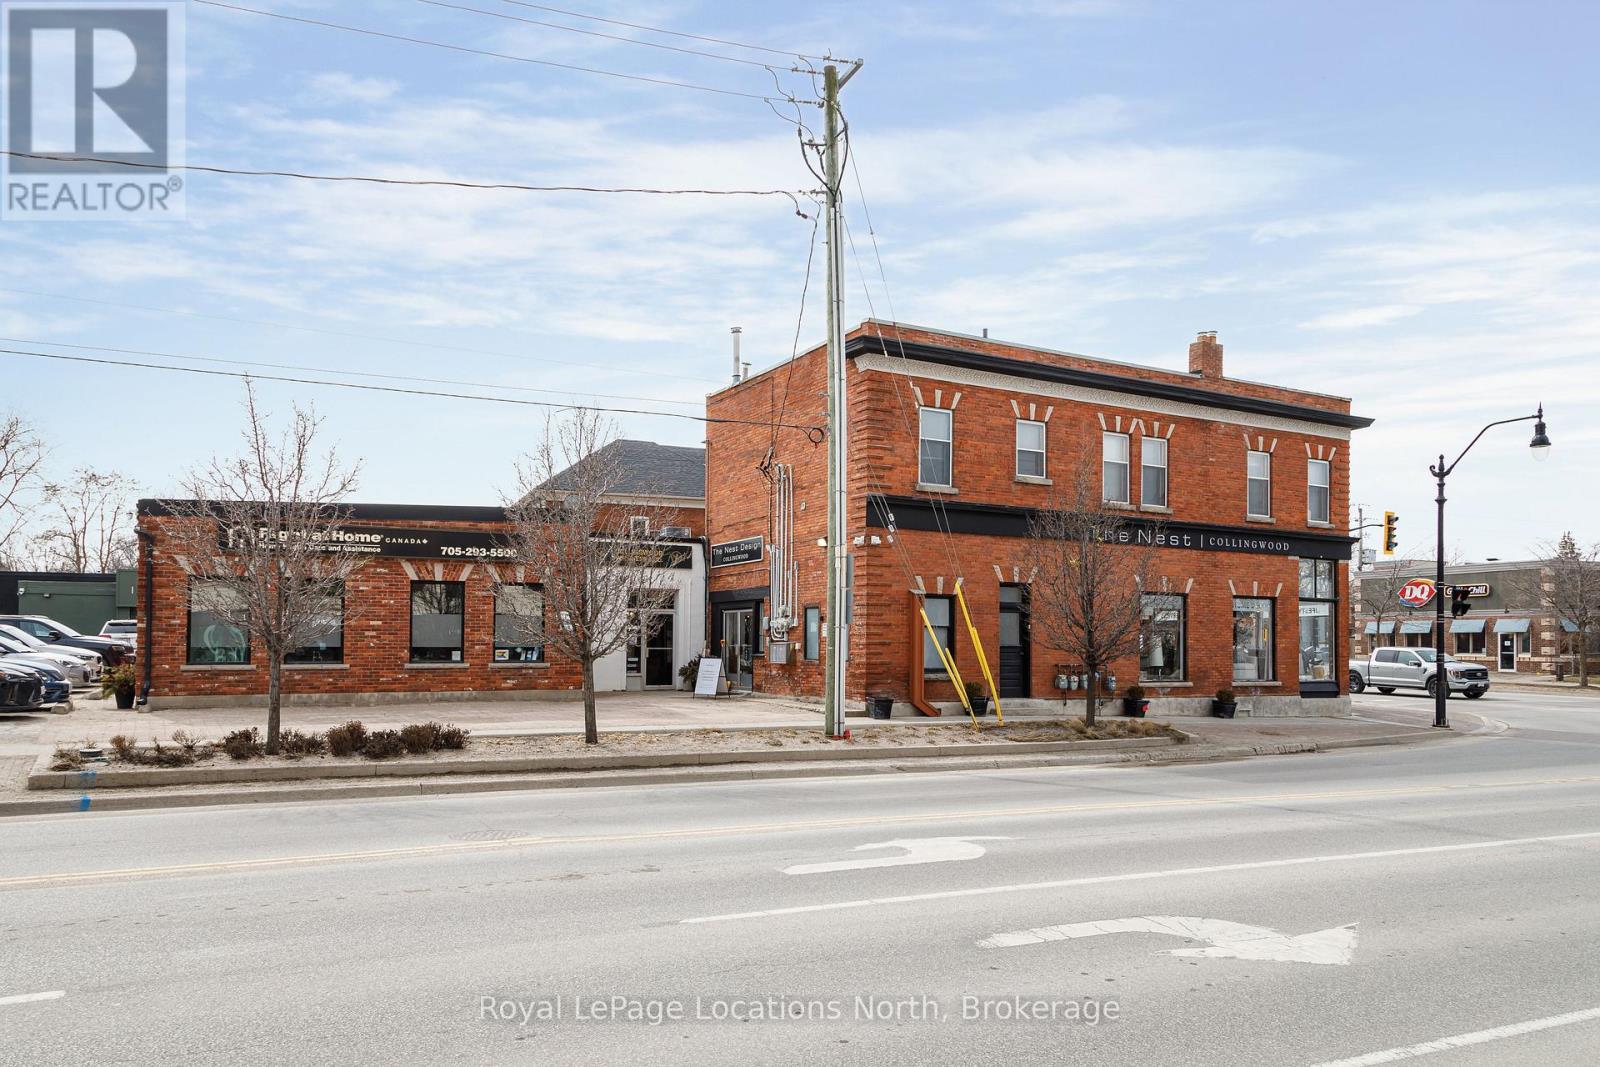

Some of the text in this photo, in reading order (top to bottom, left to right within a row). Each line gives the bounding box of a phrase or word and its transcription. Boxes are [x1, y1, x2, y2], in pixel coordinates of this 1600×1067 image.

[332, 530, 382, 543] Home
[1137, 529, 1191, 547] Nest
[713, 548, 723, 556] The
[724, 545, 739, 554] Nest
[1209, 537, 1290, 551] COLLINGWOOD
[440, 546, 518, 557] 705-293-5500
[1404, 584, 1430, 601] DQ
